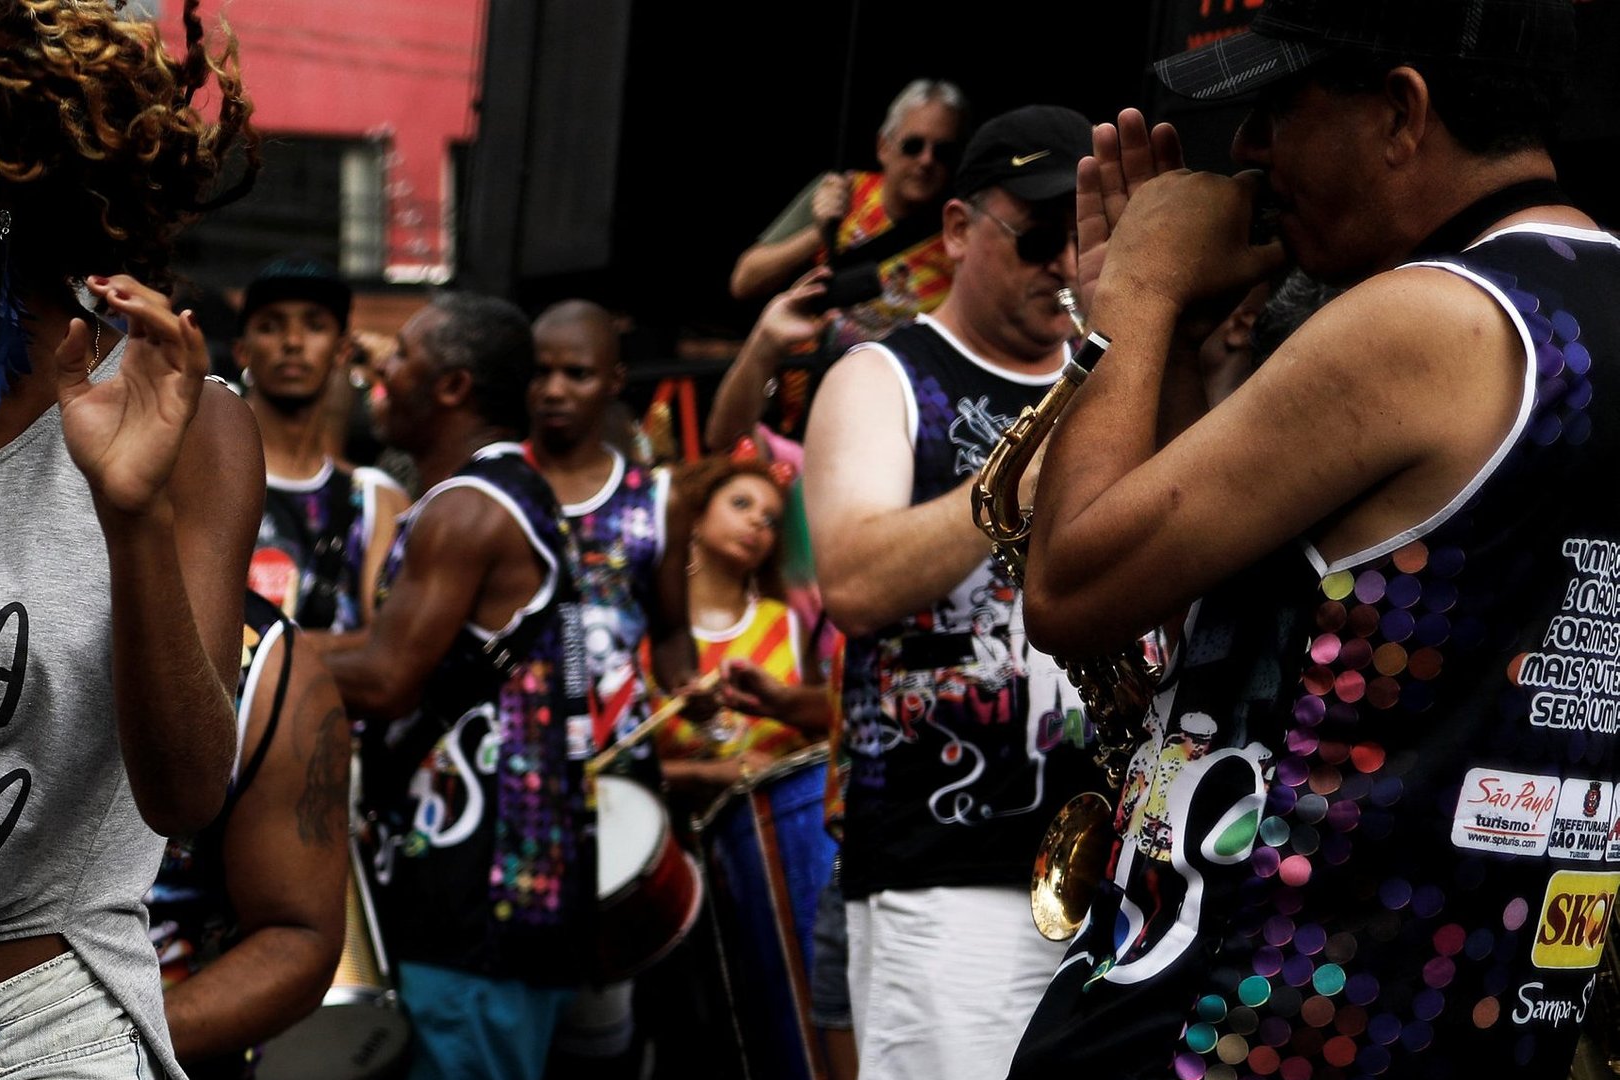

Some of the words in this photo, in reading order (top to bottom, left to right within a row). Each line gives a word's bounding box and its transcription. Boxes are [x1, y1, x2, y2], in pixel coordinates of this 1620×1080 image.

[1577, 572, 1614, 615] NÃO
[1542, 615, 1620, 656] FORMAS
[1517, 652, 1585, 690] MAIS
[1529, 689, 1591, 731] SERÁ
[1468, 777, 1511, 808] São
[1511, 780, 1556, 823] Paulo
[1468, 832, 1536, 848] www.spturis.com
[1475, 813, 1530, 833] turismo
[1576, 833, 1608, 851] PAULO
